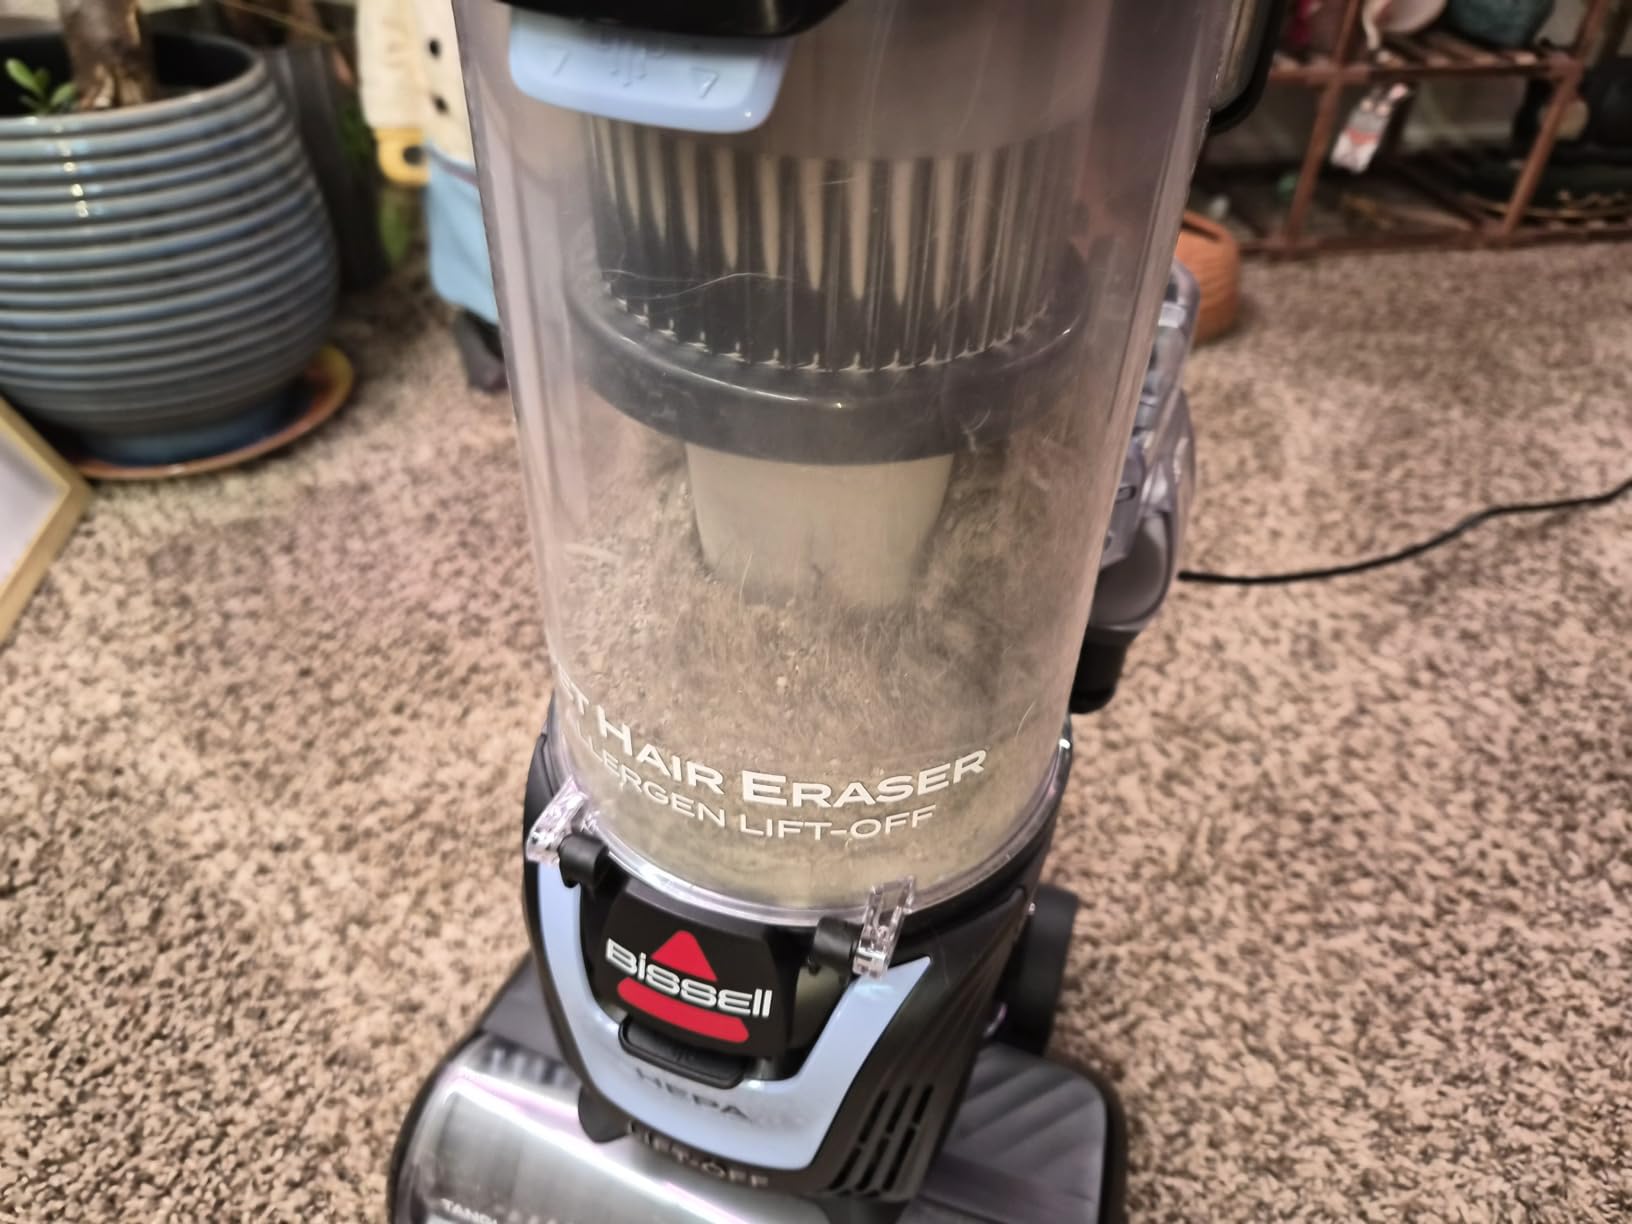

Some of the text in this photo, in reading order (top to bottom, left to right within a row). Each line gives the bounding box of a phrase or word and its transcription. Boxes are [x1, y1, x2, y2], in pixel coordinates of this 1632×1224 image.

[595, 704, 726, 795] HAIR
[741, 749, 988, 808] ERASER
[738, 804, 938, 841] LIFT-OFF
